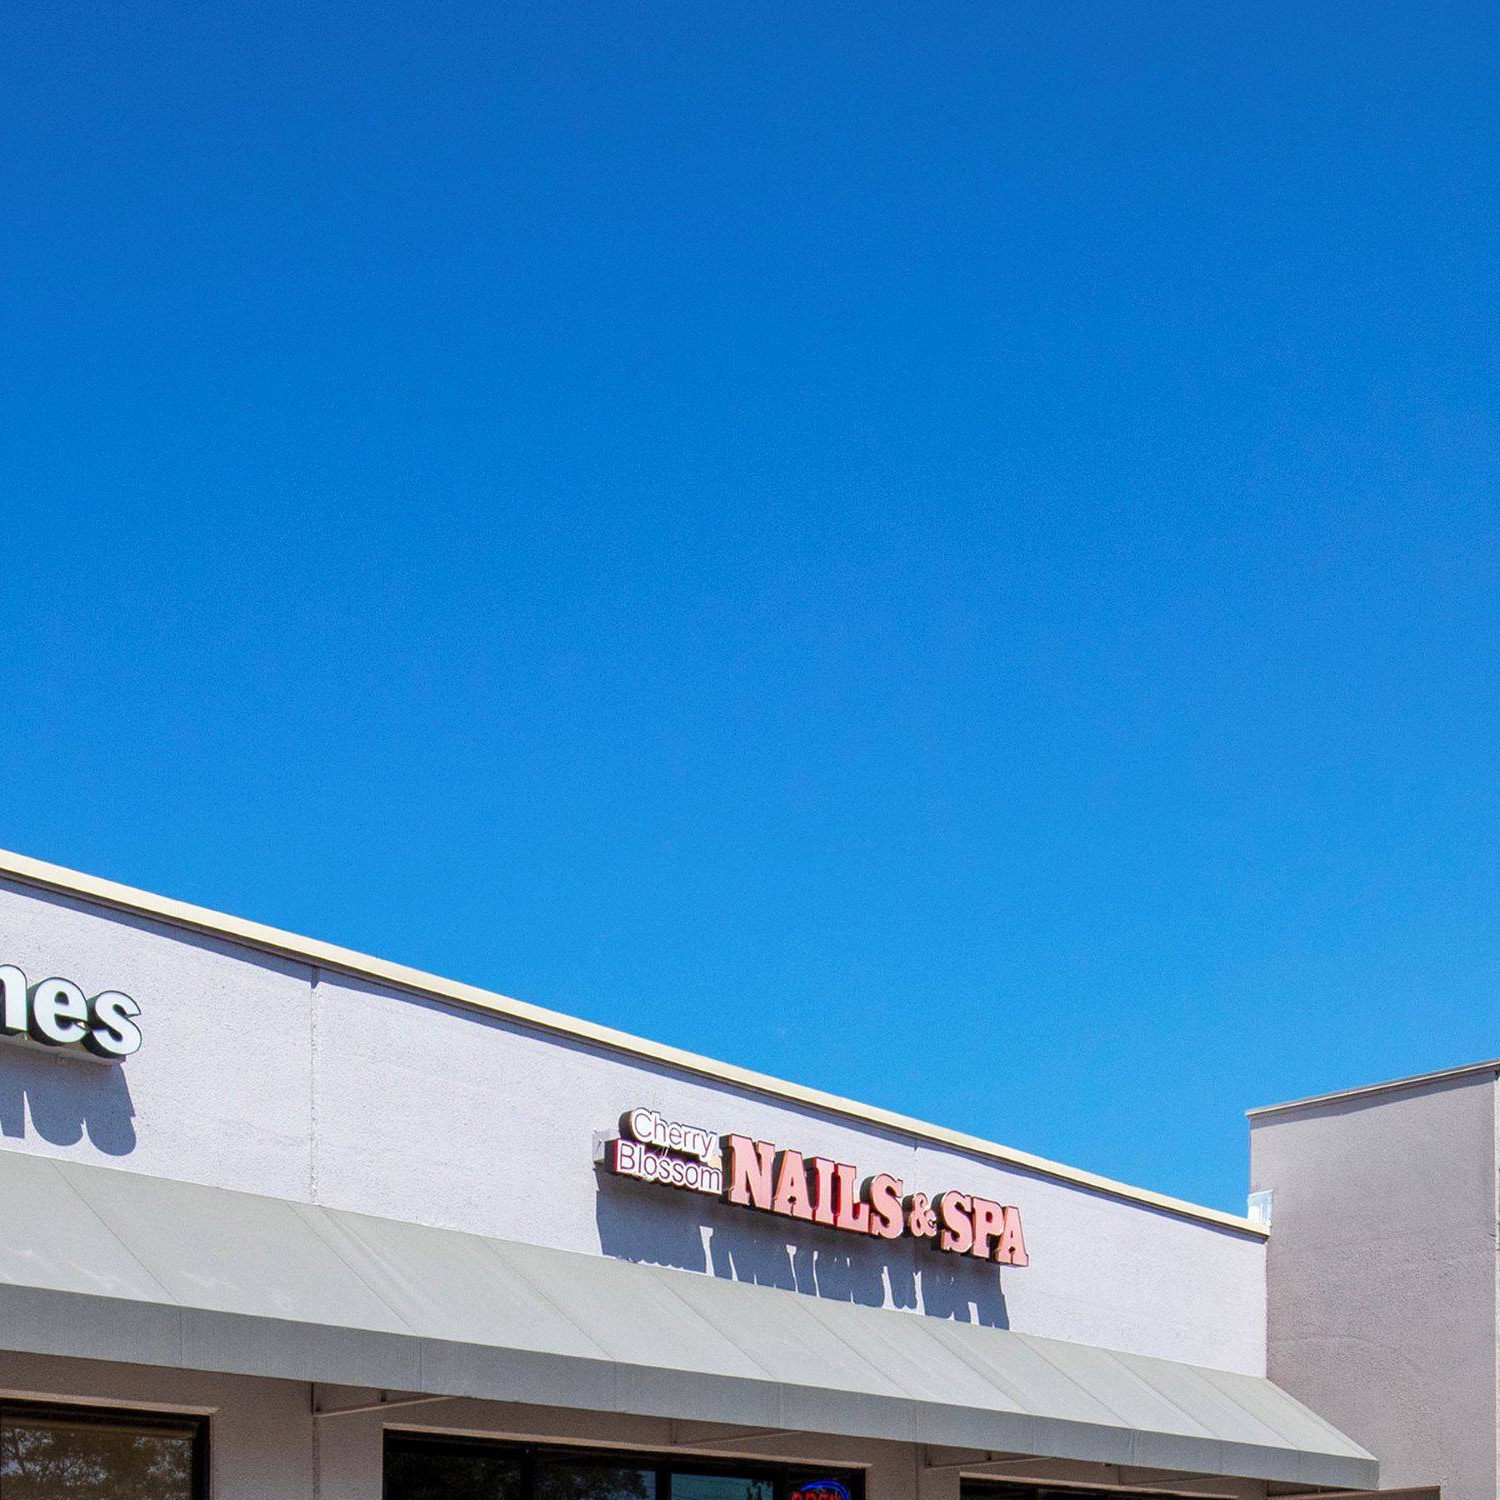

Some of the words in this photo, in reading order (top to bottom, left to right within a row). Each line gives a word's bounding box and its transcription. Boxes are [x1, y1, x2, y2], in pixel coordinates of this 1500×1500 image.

[624, 1107, 719, 1159] Cherry
[616, 1138, 723, 1195] Blossom
[724, 1133, 904, 1240] NAILS
[908, 1191, 938, 1238] &
[937, 1190, 1029, 1267] SPA
